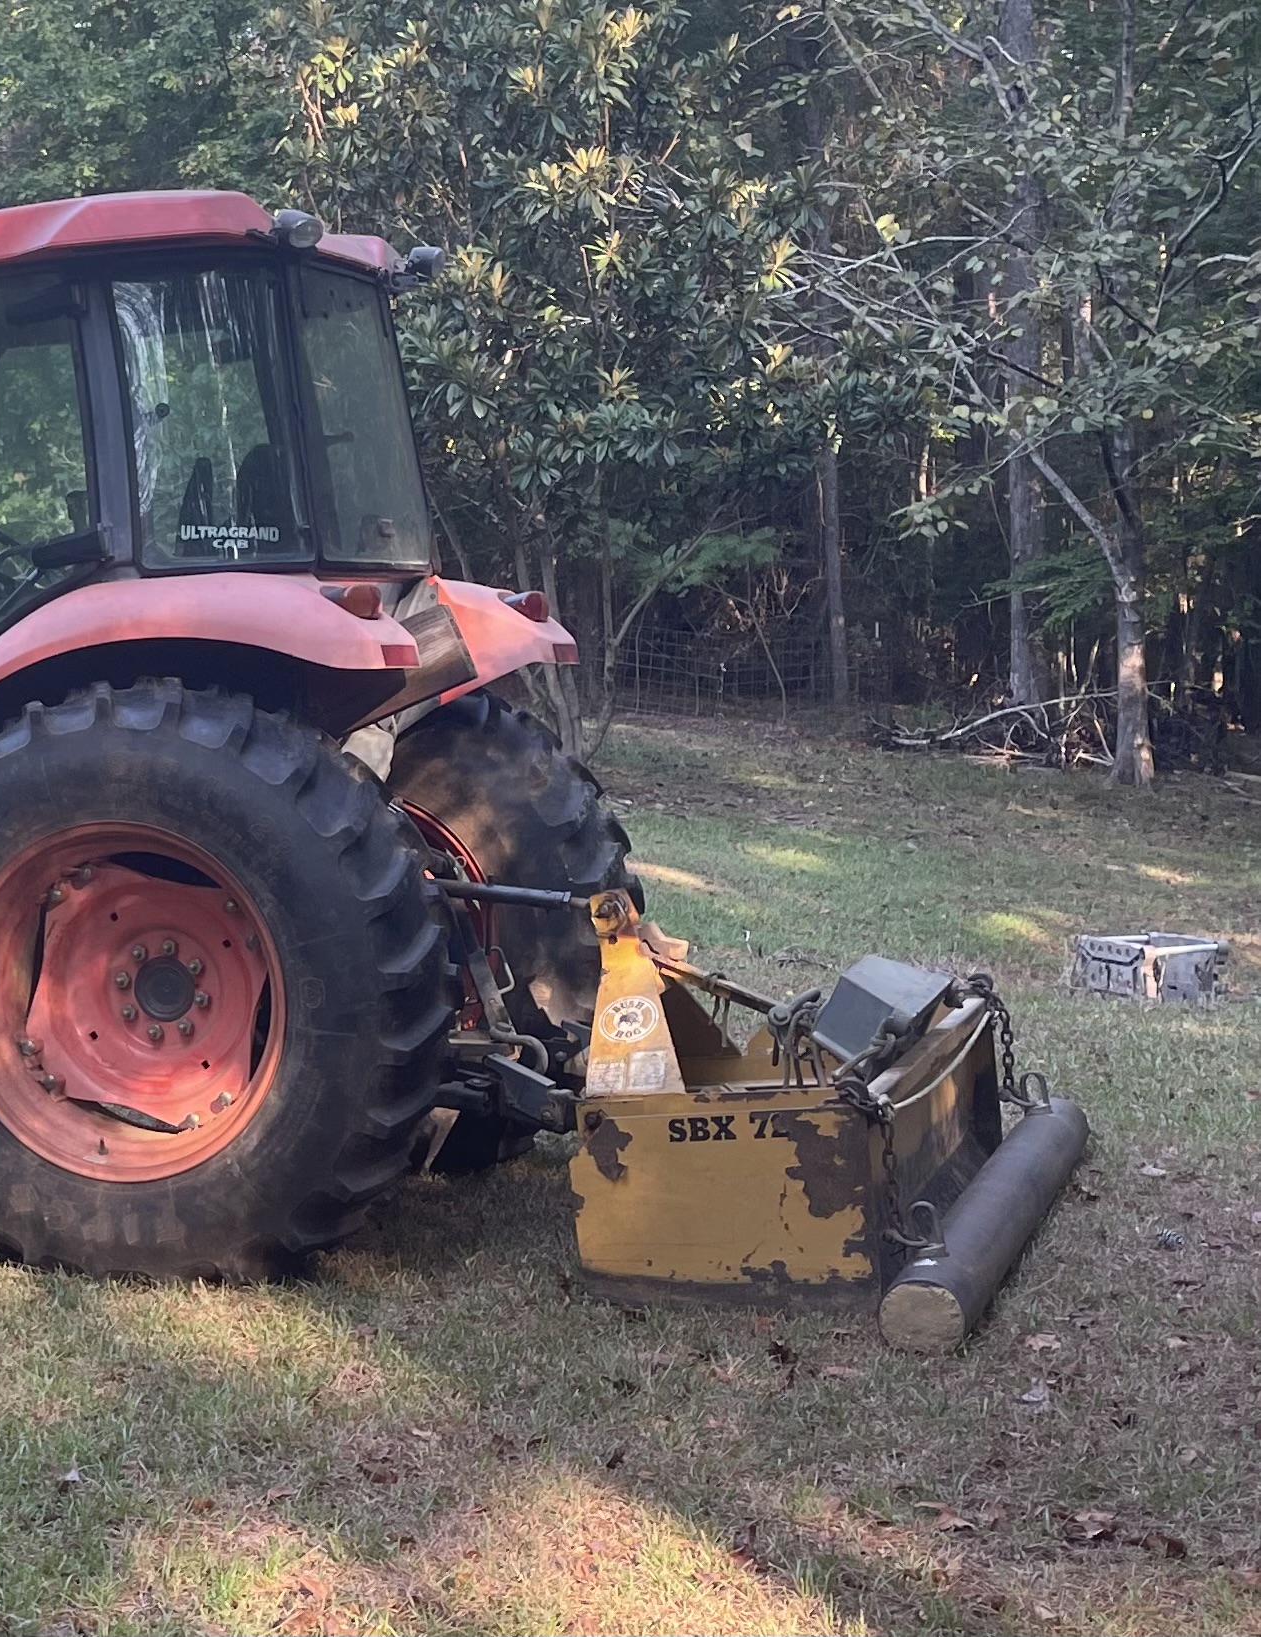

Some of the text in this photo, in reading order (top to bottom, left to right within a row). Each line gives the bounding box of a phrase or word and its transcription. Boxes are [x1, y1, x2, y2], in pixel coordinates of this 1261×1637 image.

[180, 524, 280, 542] ULTRAGRAND
[212, 538, 249, 549] CAB
[612, 1000, 645, 1013] BUSH
[614, 1028, 642, 1039] HOG
[668, 1115, 737, 1143] SBX
